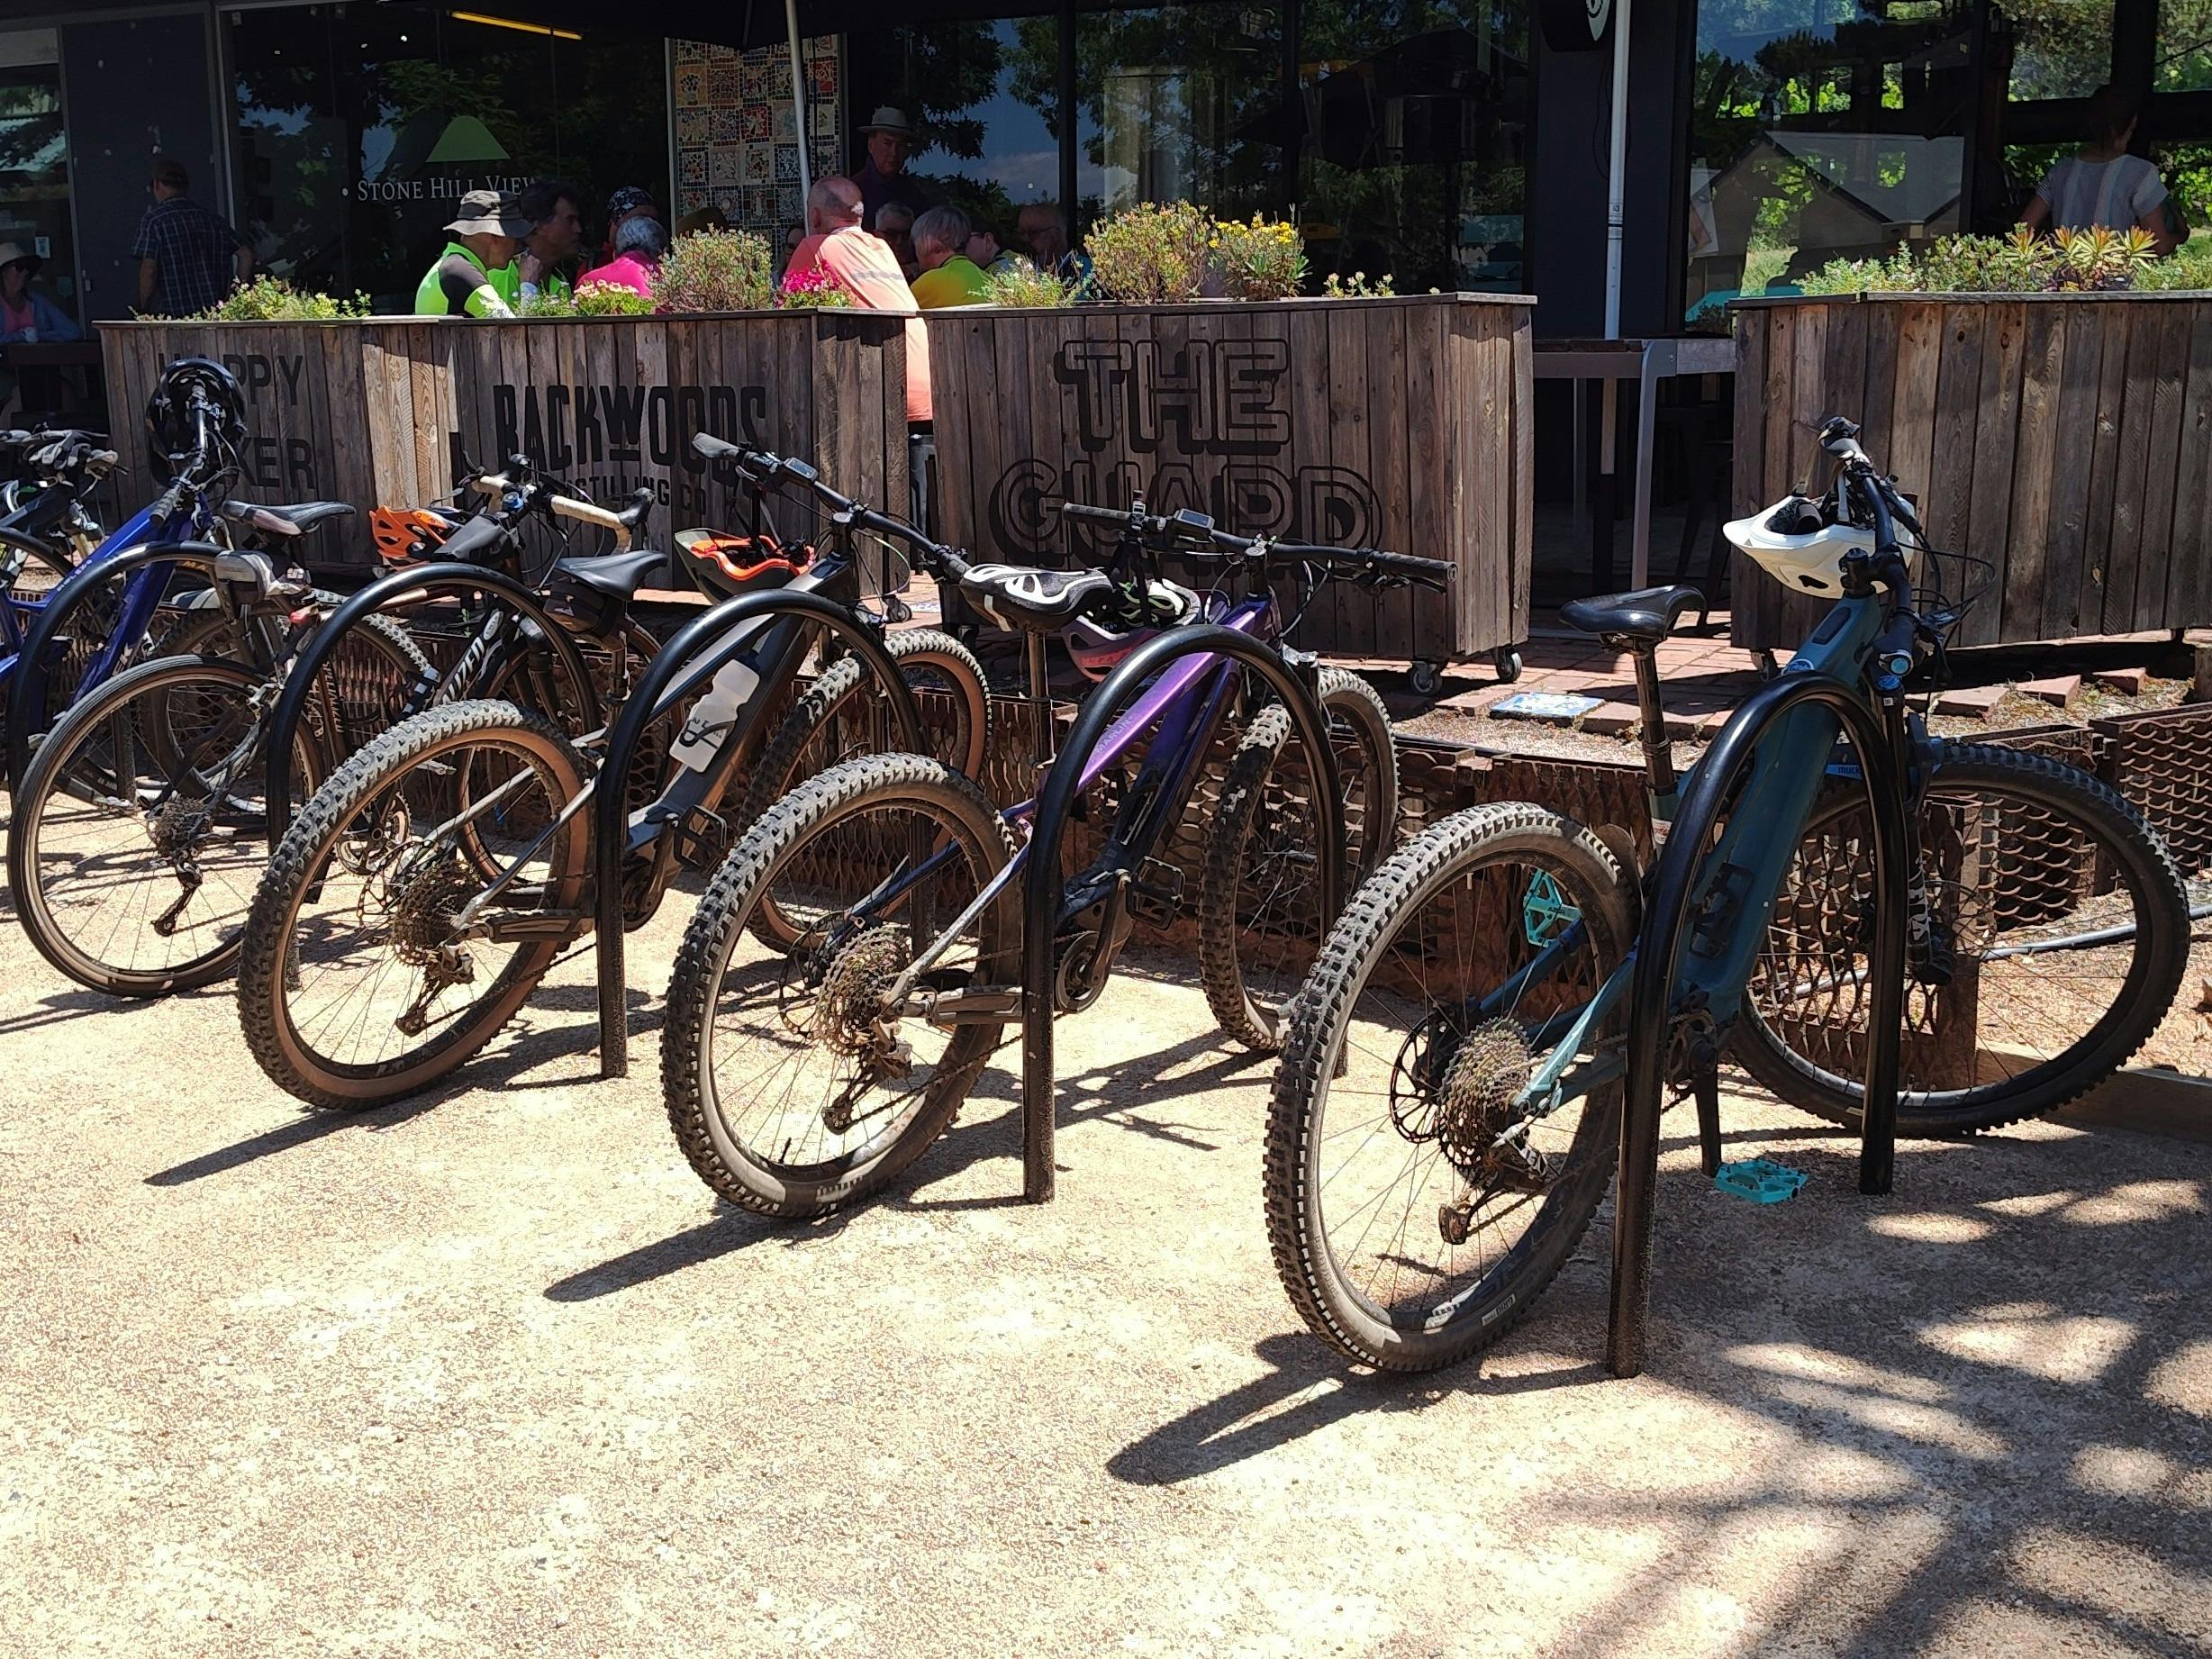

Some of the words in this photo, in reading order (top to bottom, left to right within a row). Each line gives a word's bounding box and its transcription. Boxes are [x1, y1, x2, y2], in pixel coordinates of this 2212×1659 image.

[358, 179, 423, 202] STONE
[431, 177, 475, 199] HILL
[159, 352, 304, 405] PPY
[1055, 339, 1291, 455] THE
[236, 437, 315, 489] KER
[494, 384, 766, 498] BACKWOODS
[567, 476, 670, 506] STILLING
